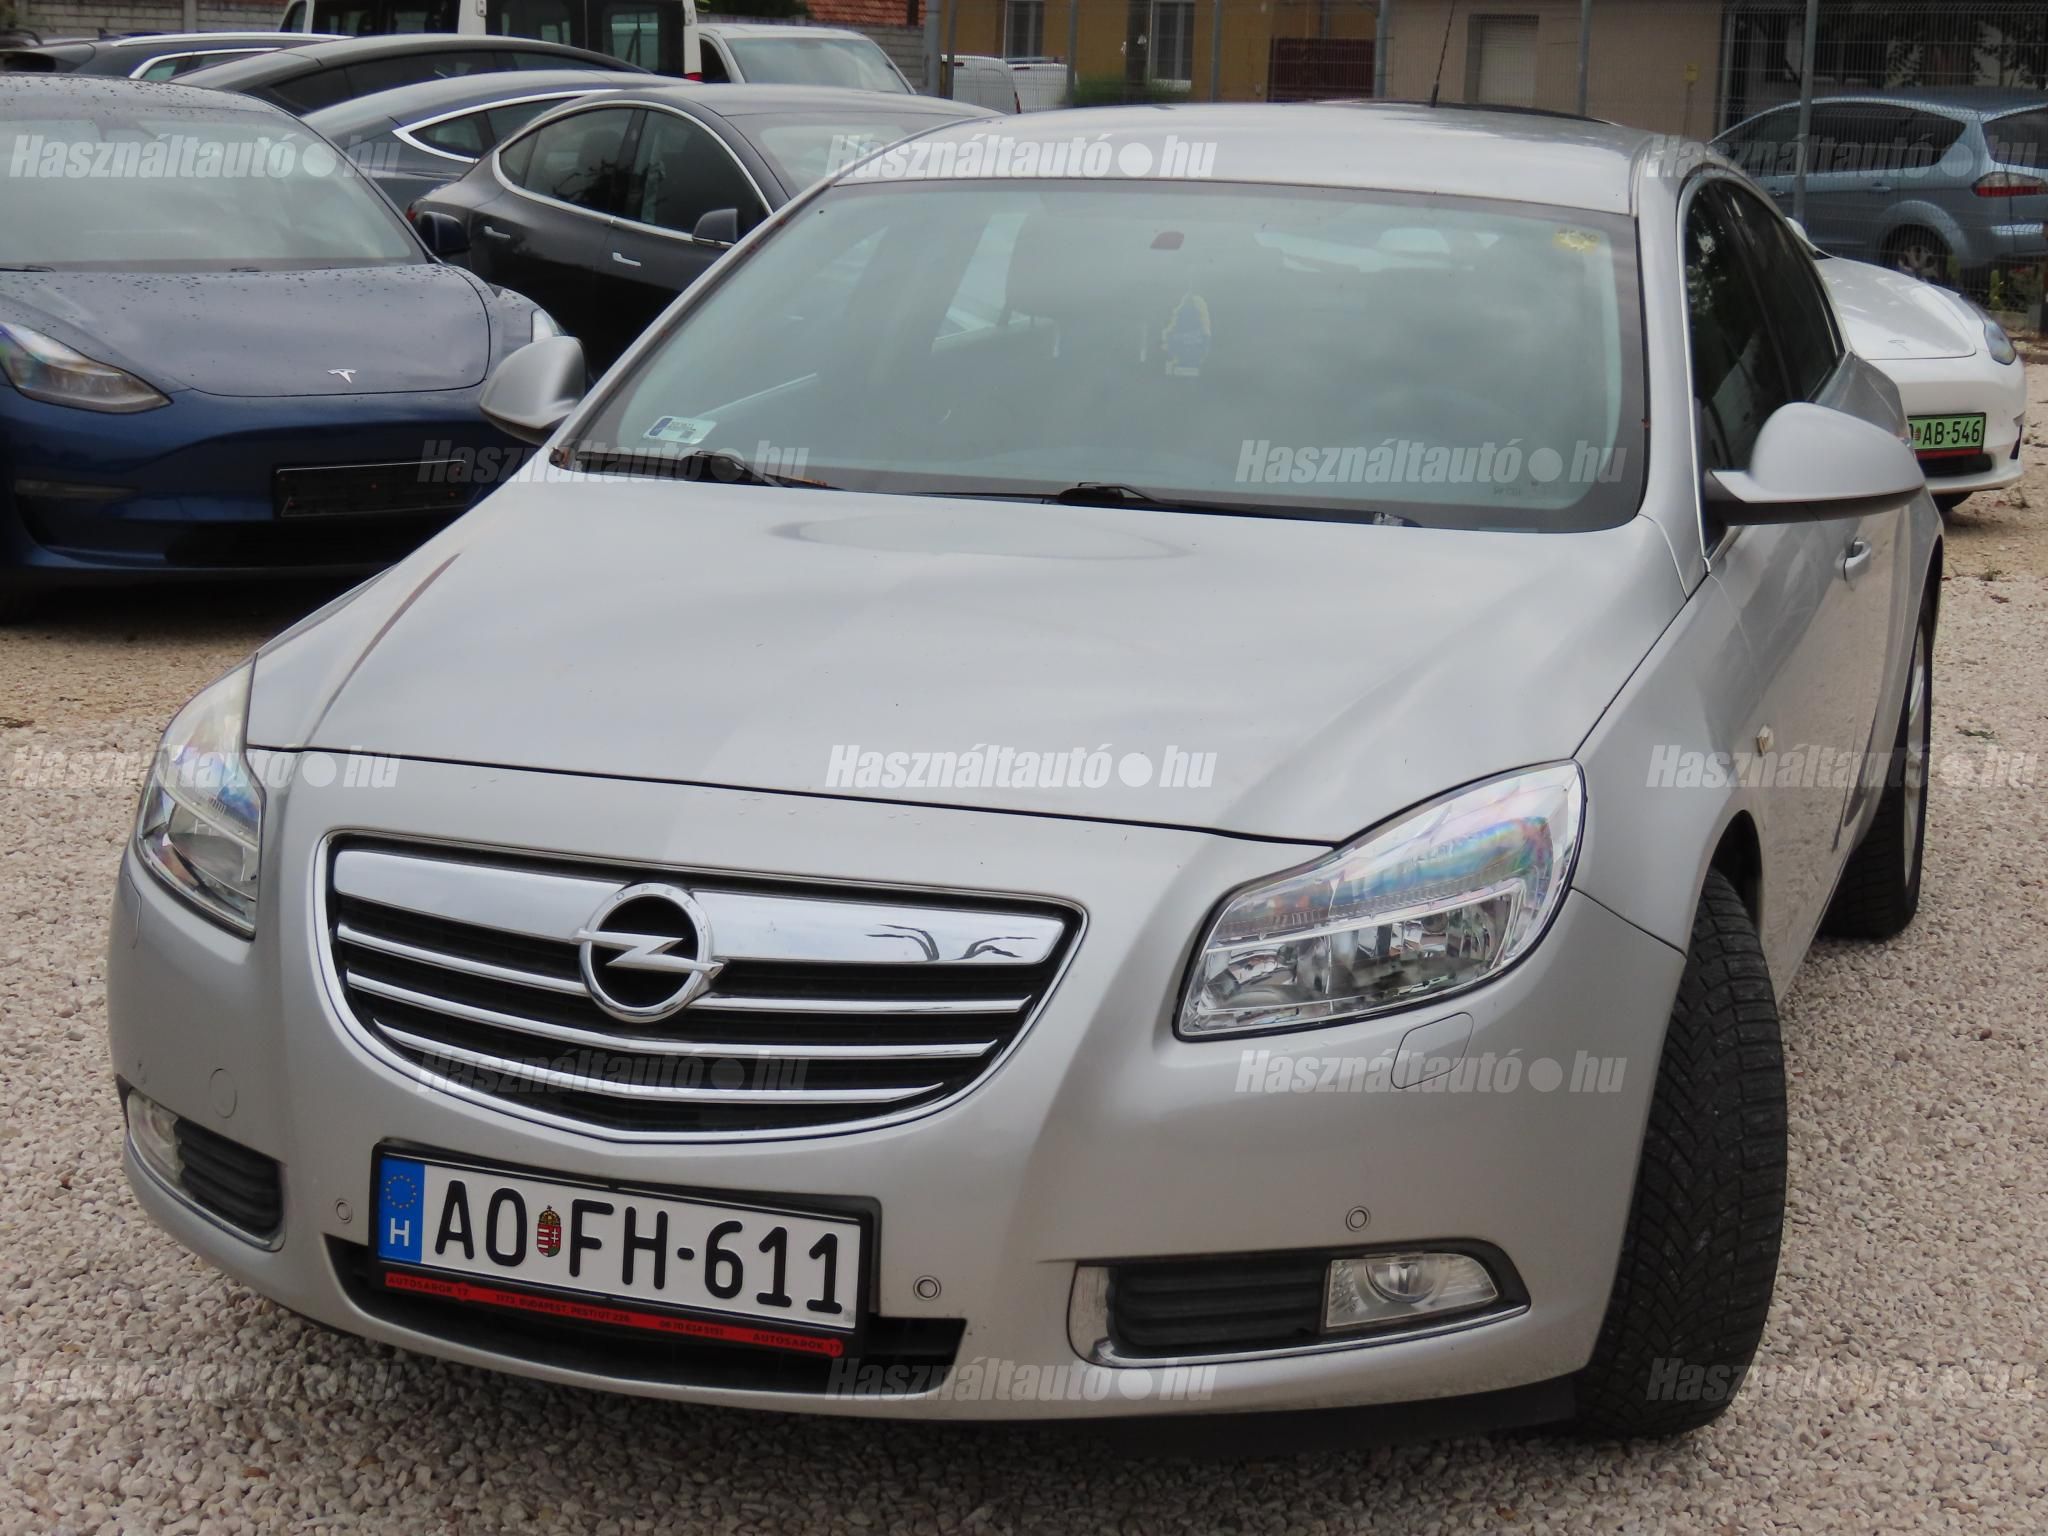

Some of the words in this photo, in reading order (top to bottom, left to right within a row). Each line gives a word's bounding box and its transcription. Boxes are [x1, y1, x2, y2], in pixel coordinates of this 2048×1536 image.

[1922, 419, 1981, 446] AB-546
[389, 1217, 410, 1247] H
[569, 1198, 844, 1314] FH-611
